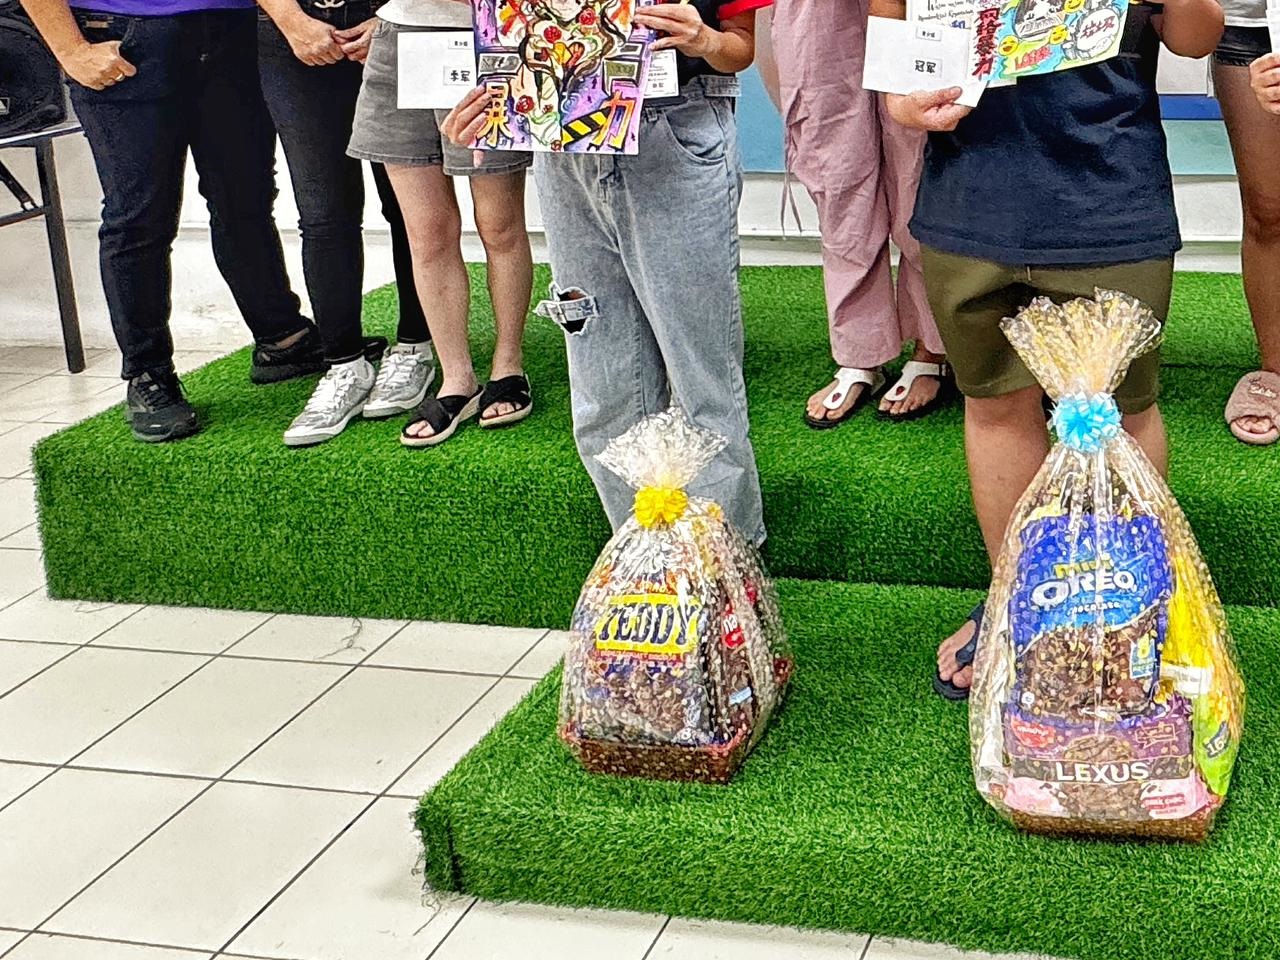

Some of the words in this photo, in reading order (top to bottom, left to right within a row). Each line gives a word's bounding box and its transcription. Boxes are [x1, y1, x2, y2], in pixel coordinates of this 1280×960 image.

[449, 69, 471, 83] 季军
[1031, 568, 1136, 610] OREO
[598, 602, 701, 646] TEDDY
[1206, 738, 1225, 756] 16
[1055, 761, 1150, 785] LEXUS
